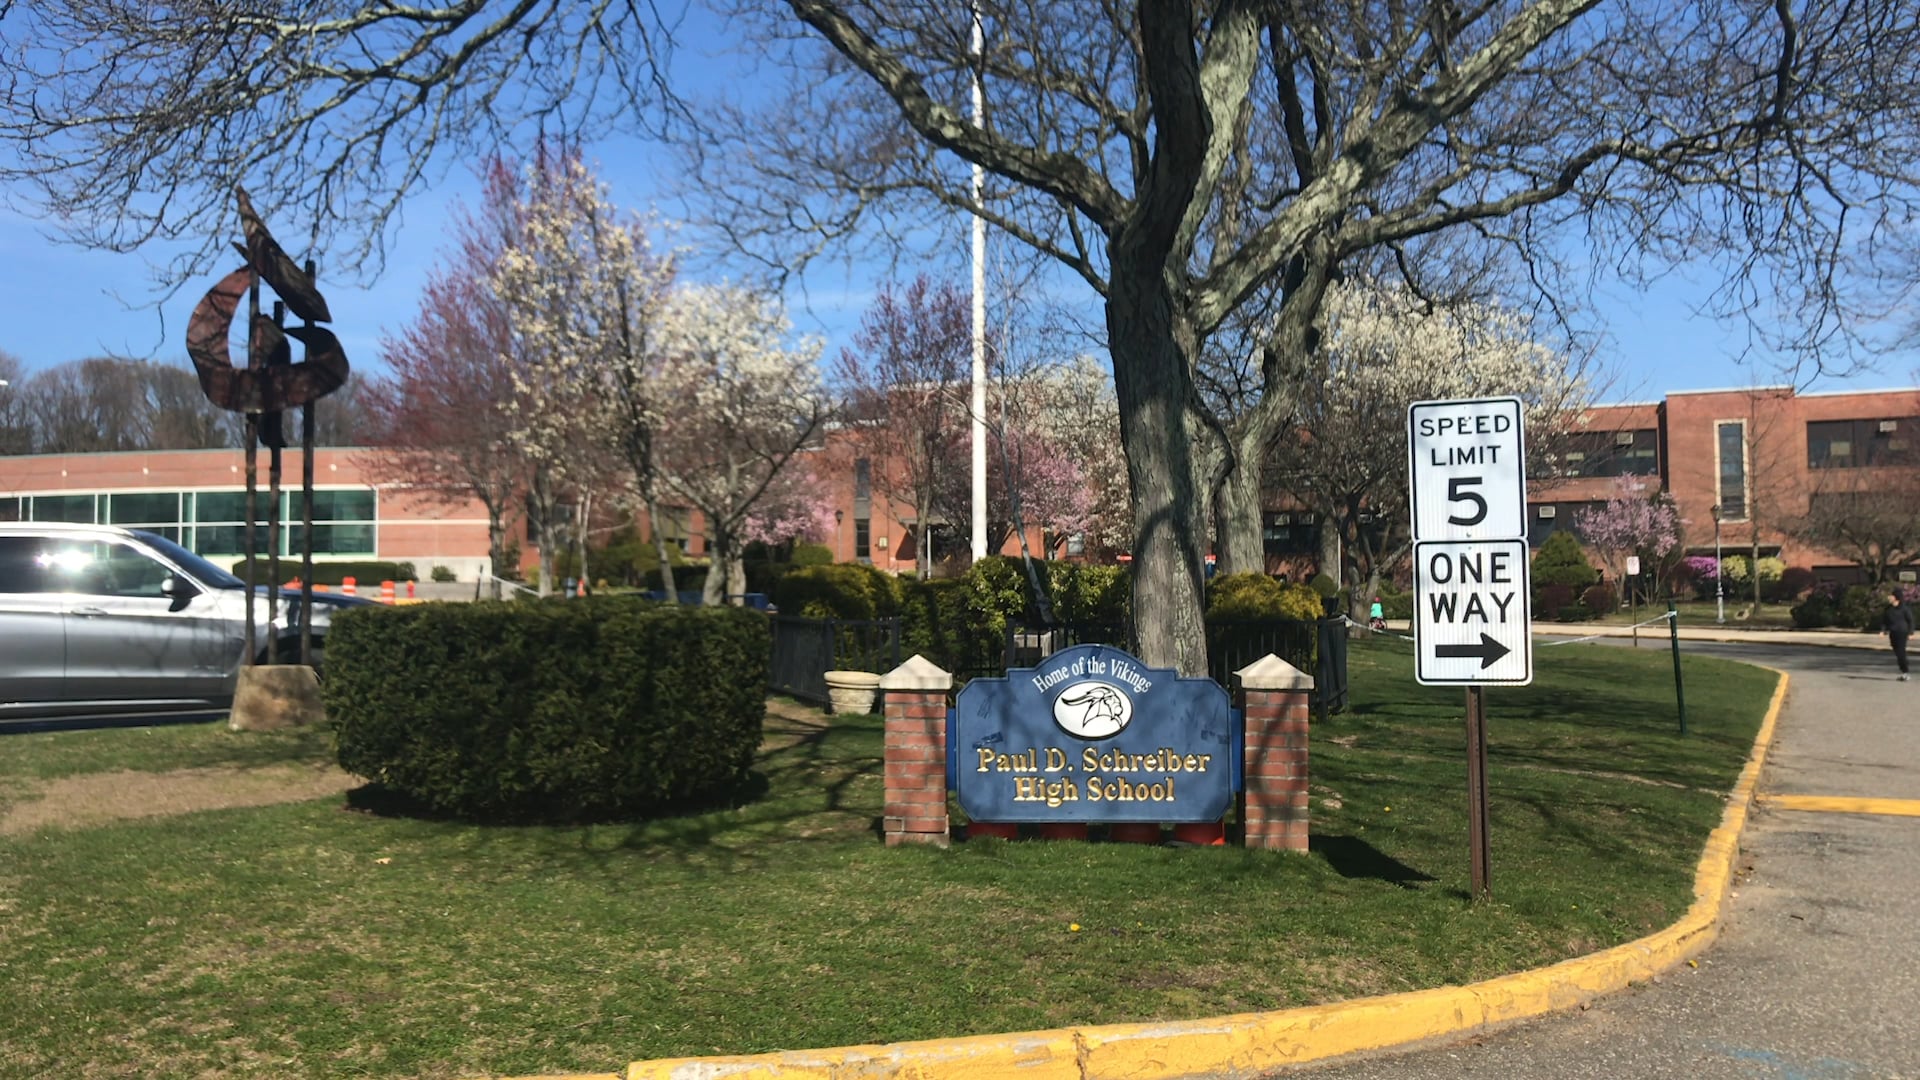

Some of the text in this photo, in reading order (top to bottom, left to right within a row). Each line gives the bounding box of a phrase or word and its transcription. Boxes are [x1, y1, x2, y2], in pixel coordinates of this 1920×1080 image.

[1419, 415, 1511, 437] SPEED
[1431, 445, 1501, 466] LIMIT
[1447, 476, 1488, 526] 5
[1430, 552, 1511, 584] ONE
[1429, 592, 1515, 623] WAY
[1031, 656, 1152, 694] Home of the Vikings
[976, 747, 1211, 773] Paul D. Schreiber
[1013, 776, 1176, 807] High School
